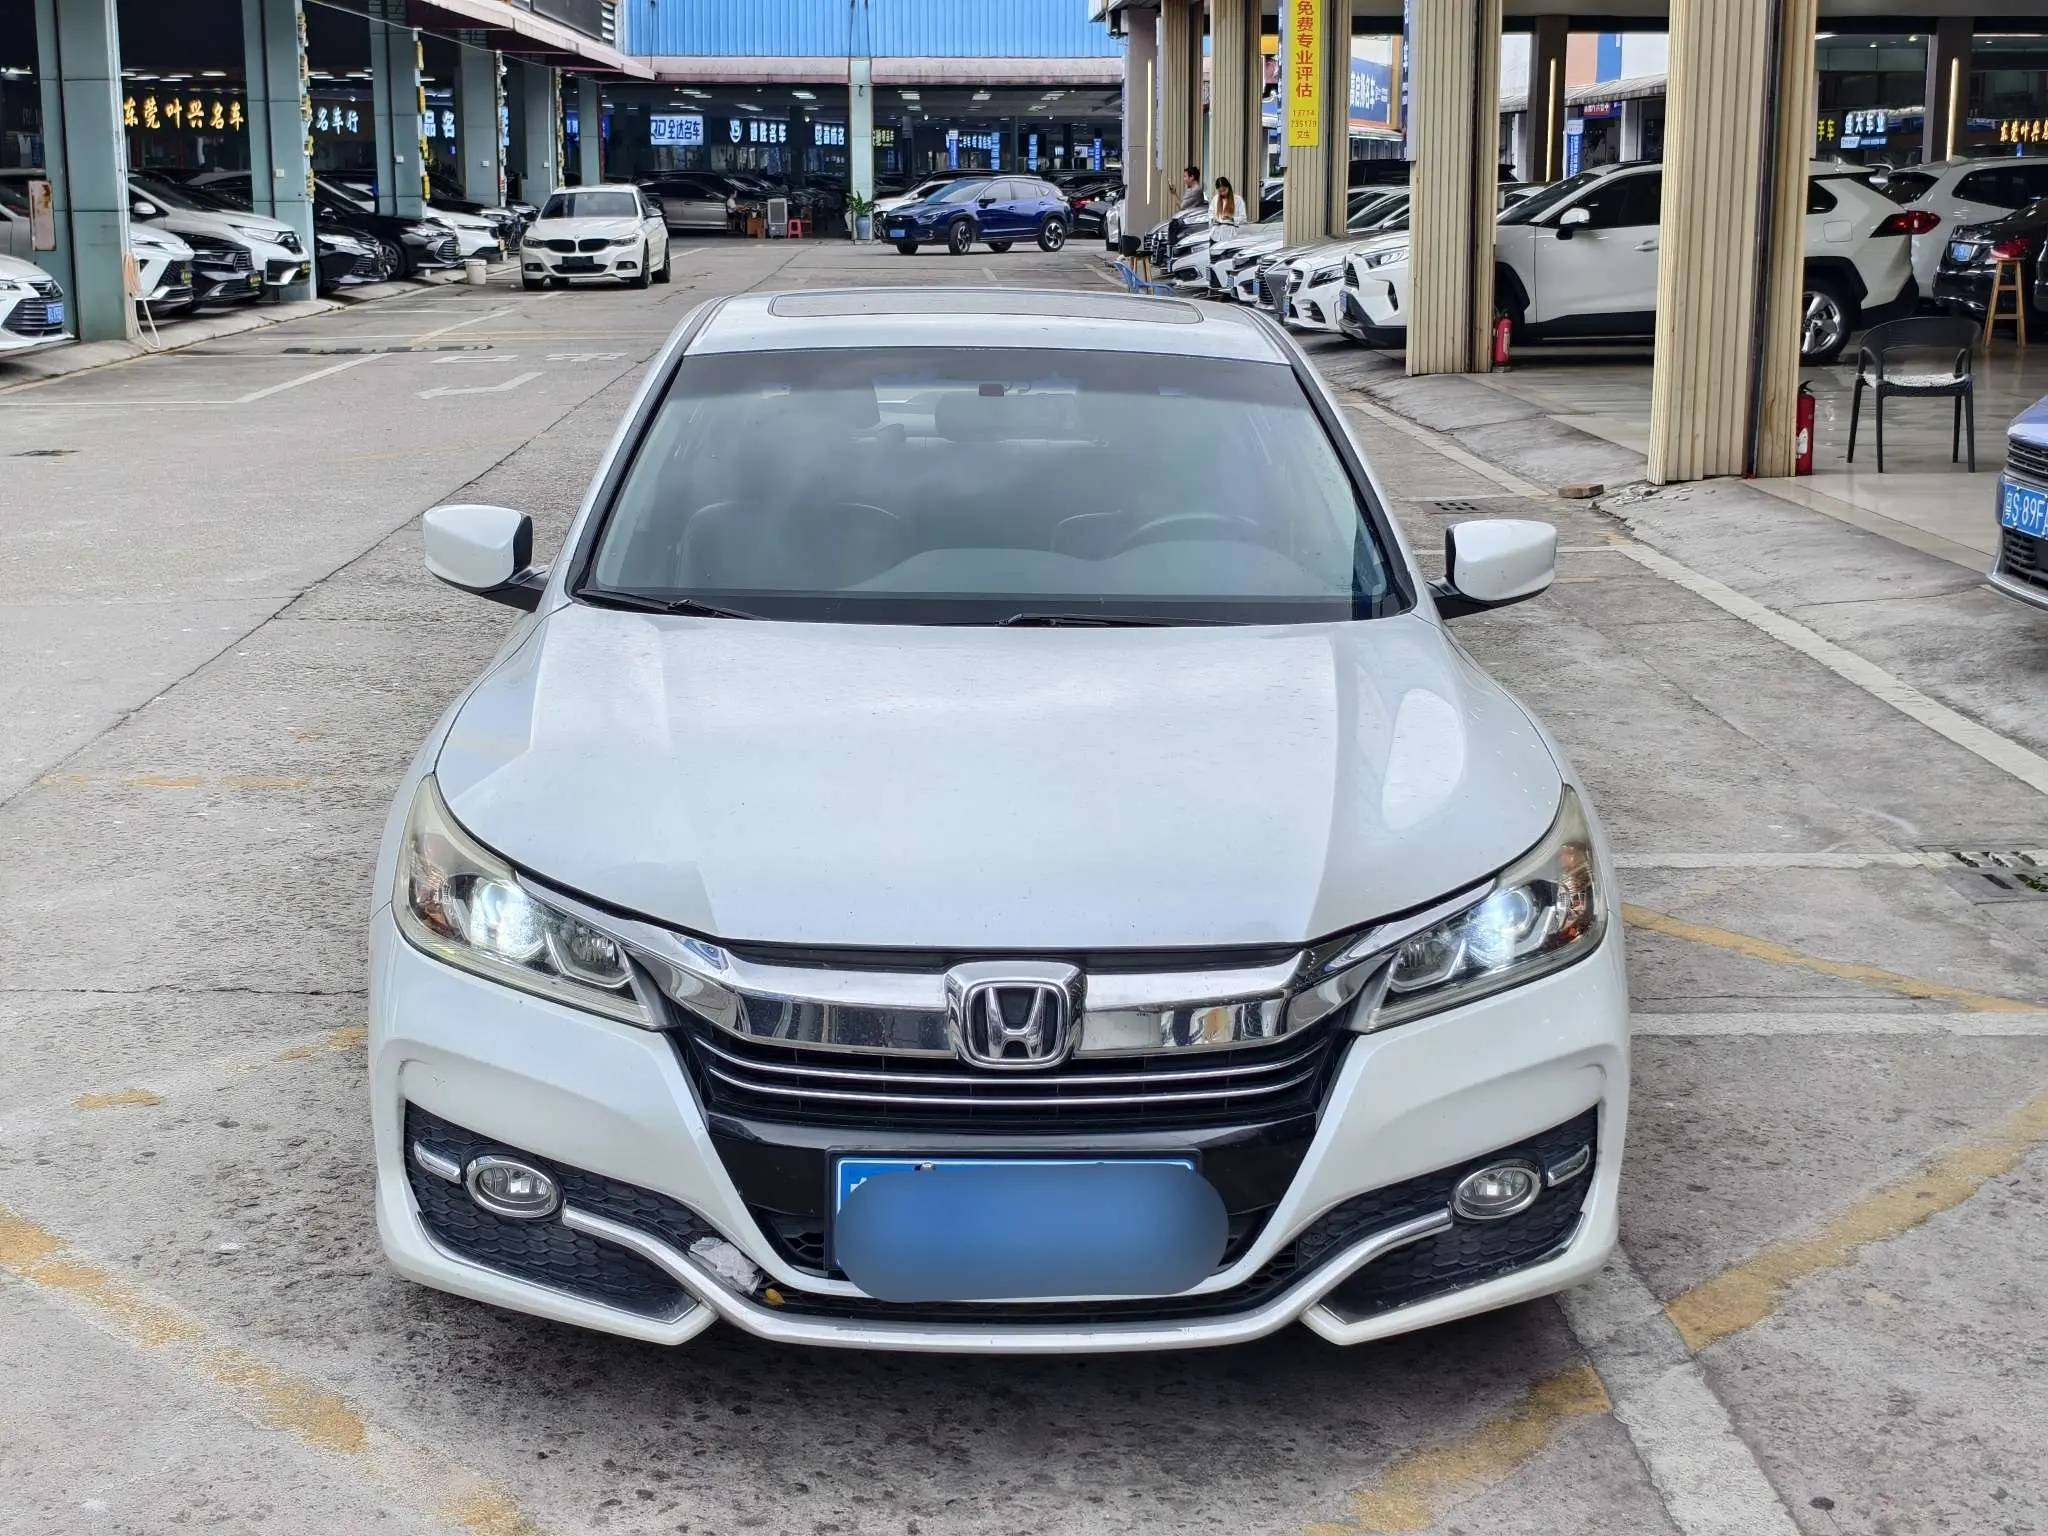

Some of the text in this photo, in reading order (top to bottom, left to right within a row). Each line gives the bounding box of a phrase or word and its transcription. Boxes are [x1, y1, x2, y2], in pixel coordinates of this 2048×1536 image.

[1296, 0, 1314, 97] 免费专业评估
[123, 96, 245, 131] 东莞叶兴名车
[667, 119, 701, 141] 全达名车
